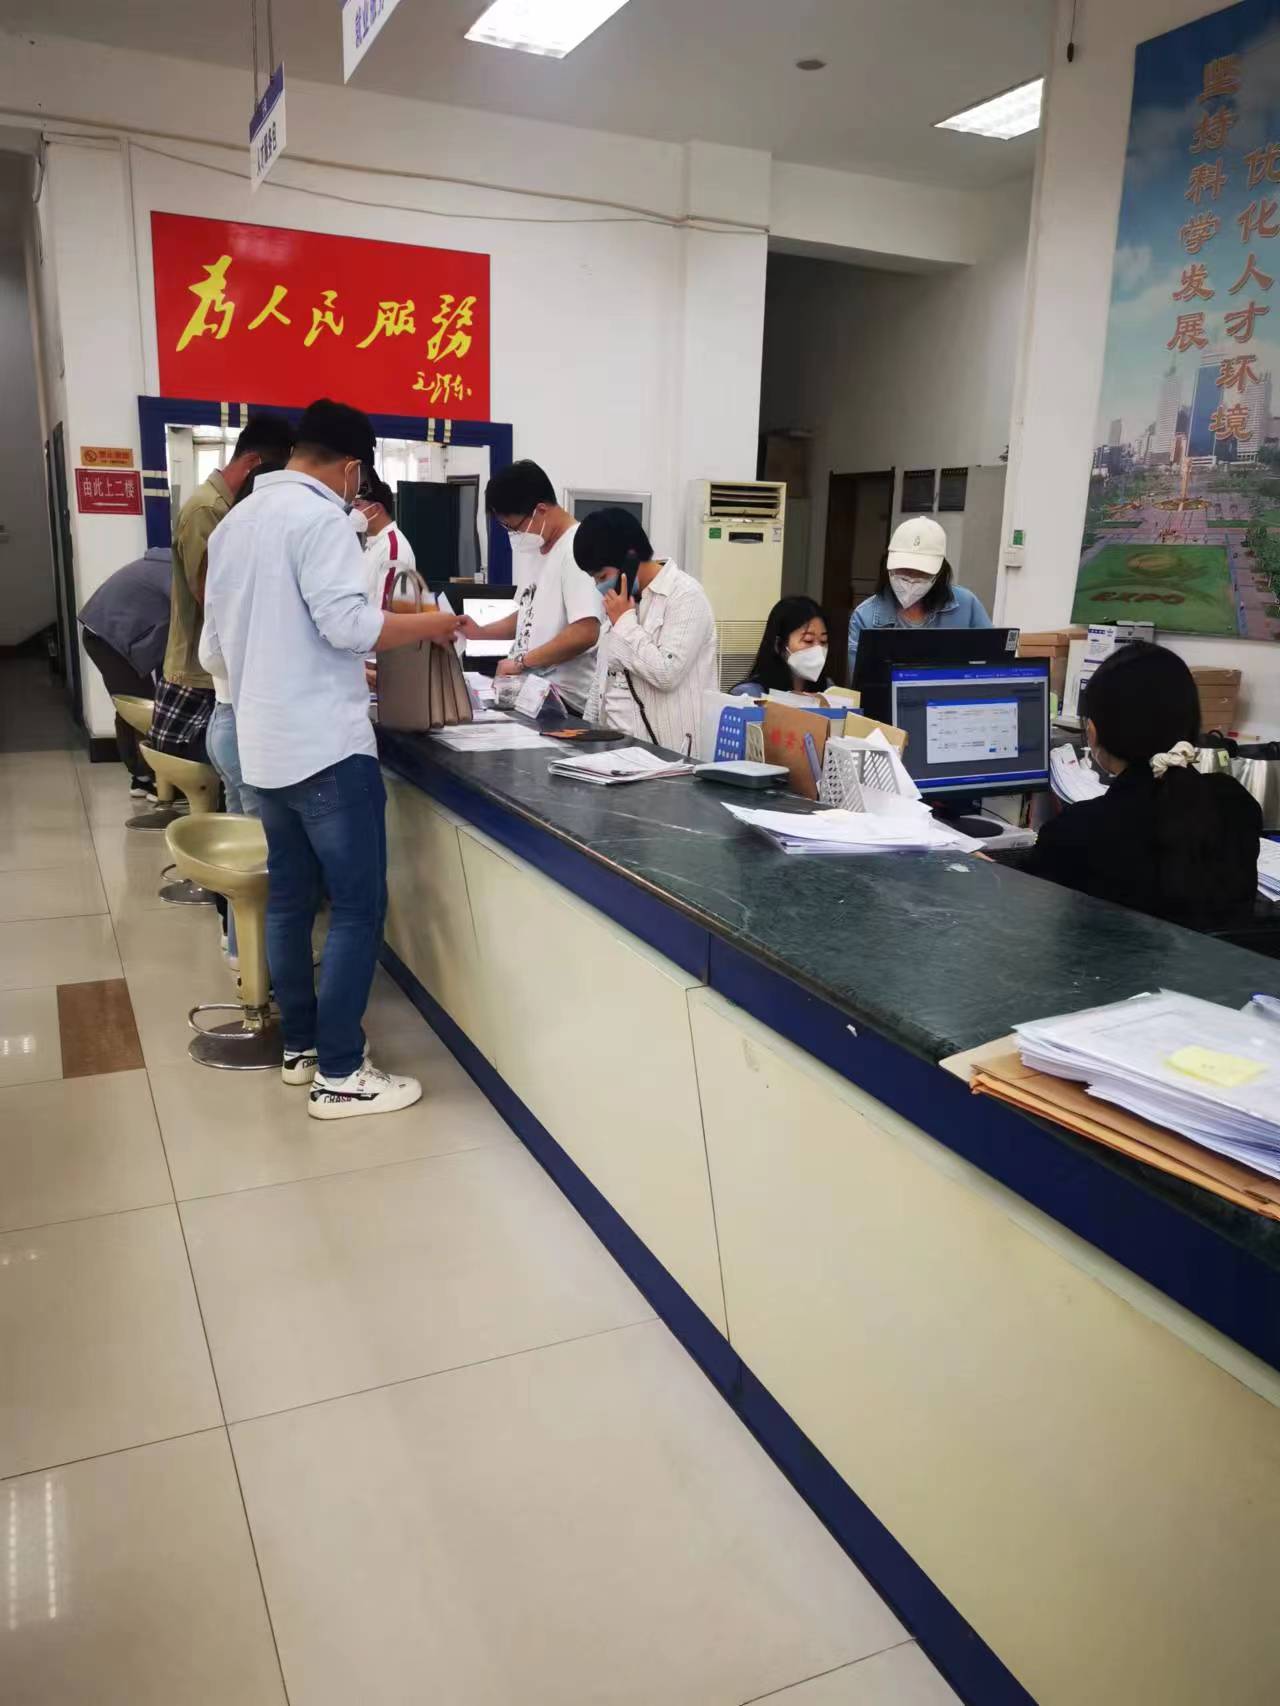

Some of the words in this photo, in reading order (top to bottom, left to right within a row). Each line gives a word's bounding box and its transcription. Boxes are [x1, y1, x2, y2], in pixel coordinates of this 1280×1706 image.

[1167, 56, 1241, 352] 坚持科学发展
[1209, 143, 1280, 441] 优化人才环境
[83, 477, 134, 498] 由此上二楼
